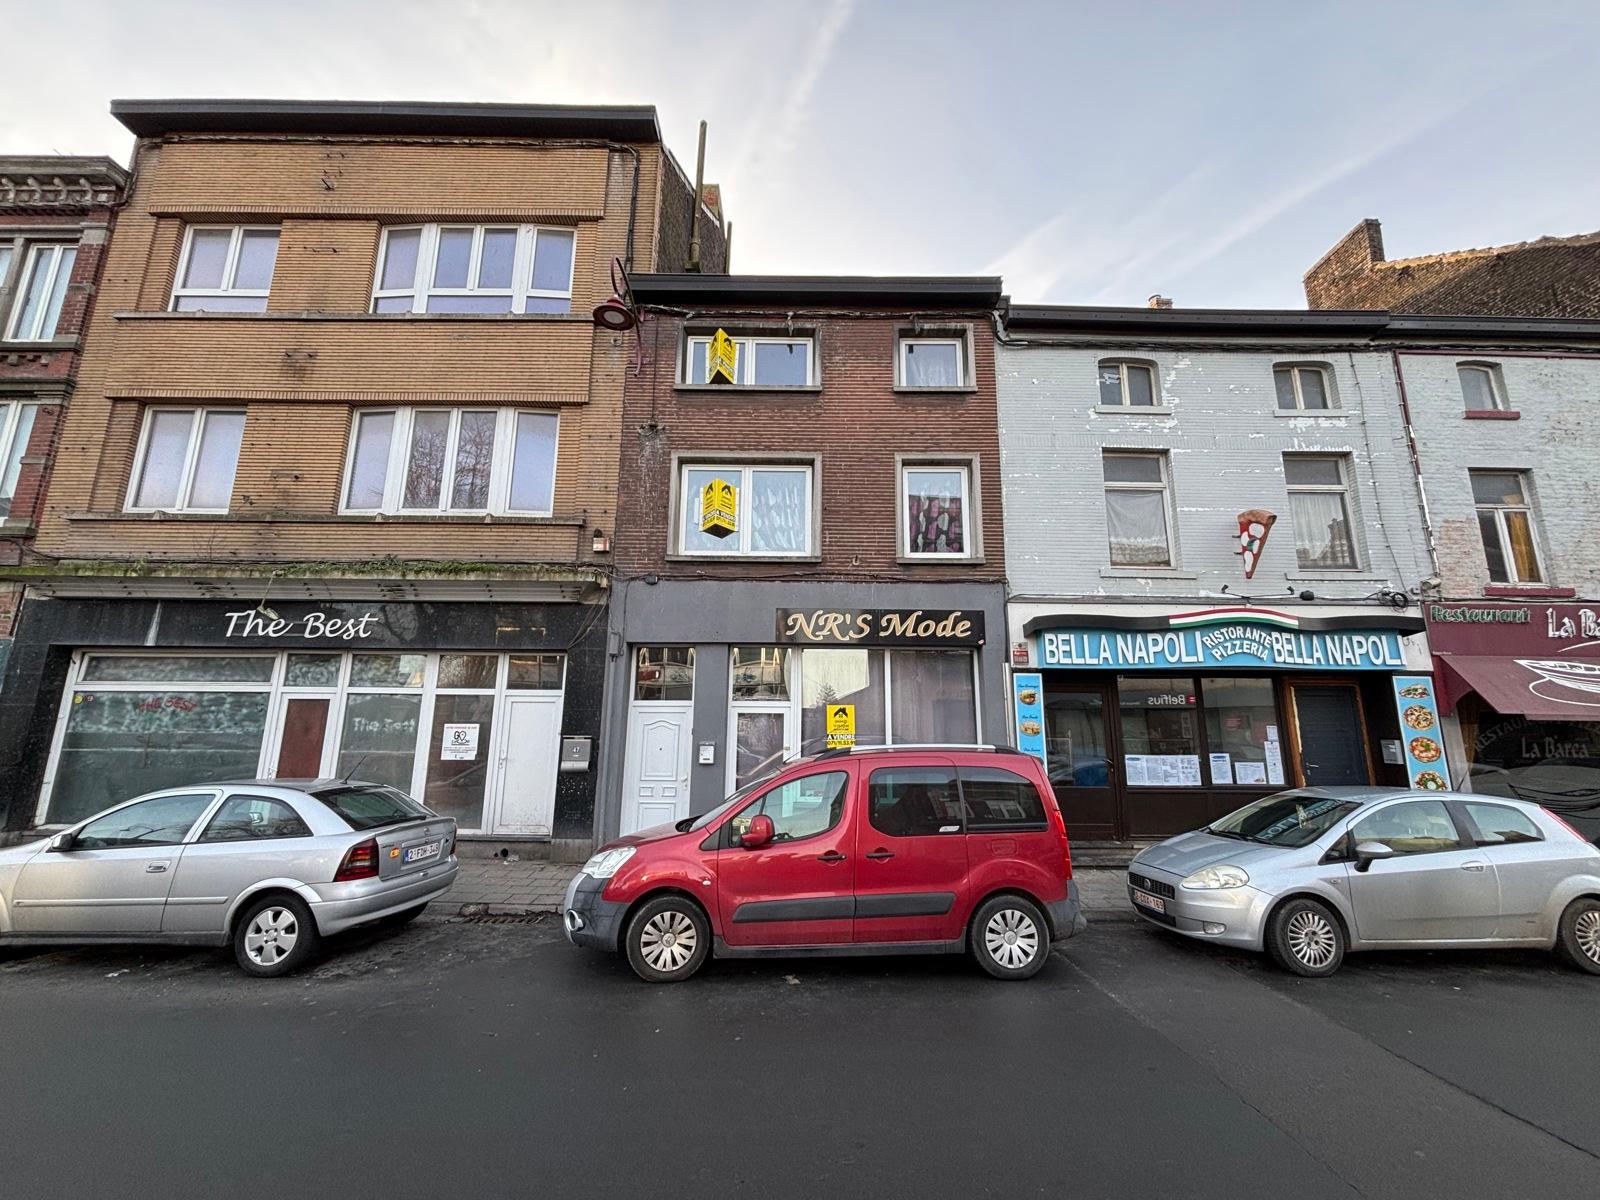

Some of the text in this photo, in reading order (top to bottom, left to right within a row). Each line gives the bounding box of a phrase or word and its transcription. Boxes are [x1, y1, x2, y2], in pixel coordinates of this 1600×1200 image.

[225, 609, 379, 640] The Best
[785, 609, 972, 641] NR'S Mode
[1430, 604, 1532, 624] Restaurant
[1546, 607, 1600, 638] La B
[1044, 633, 1114, 665] BELLA
[1116, 631, 1205, 664] NAPOLI
[1202, 626, 1273, 649] RISTORANTE
[1211, 640, 1269, 662] PIZZERIA
[1271, 631, 1408, 667] BELLA NAPOLI
